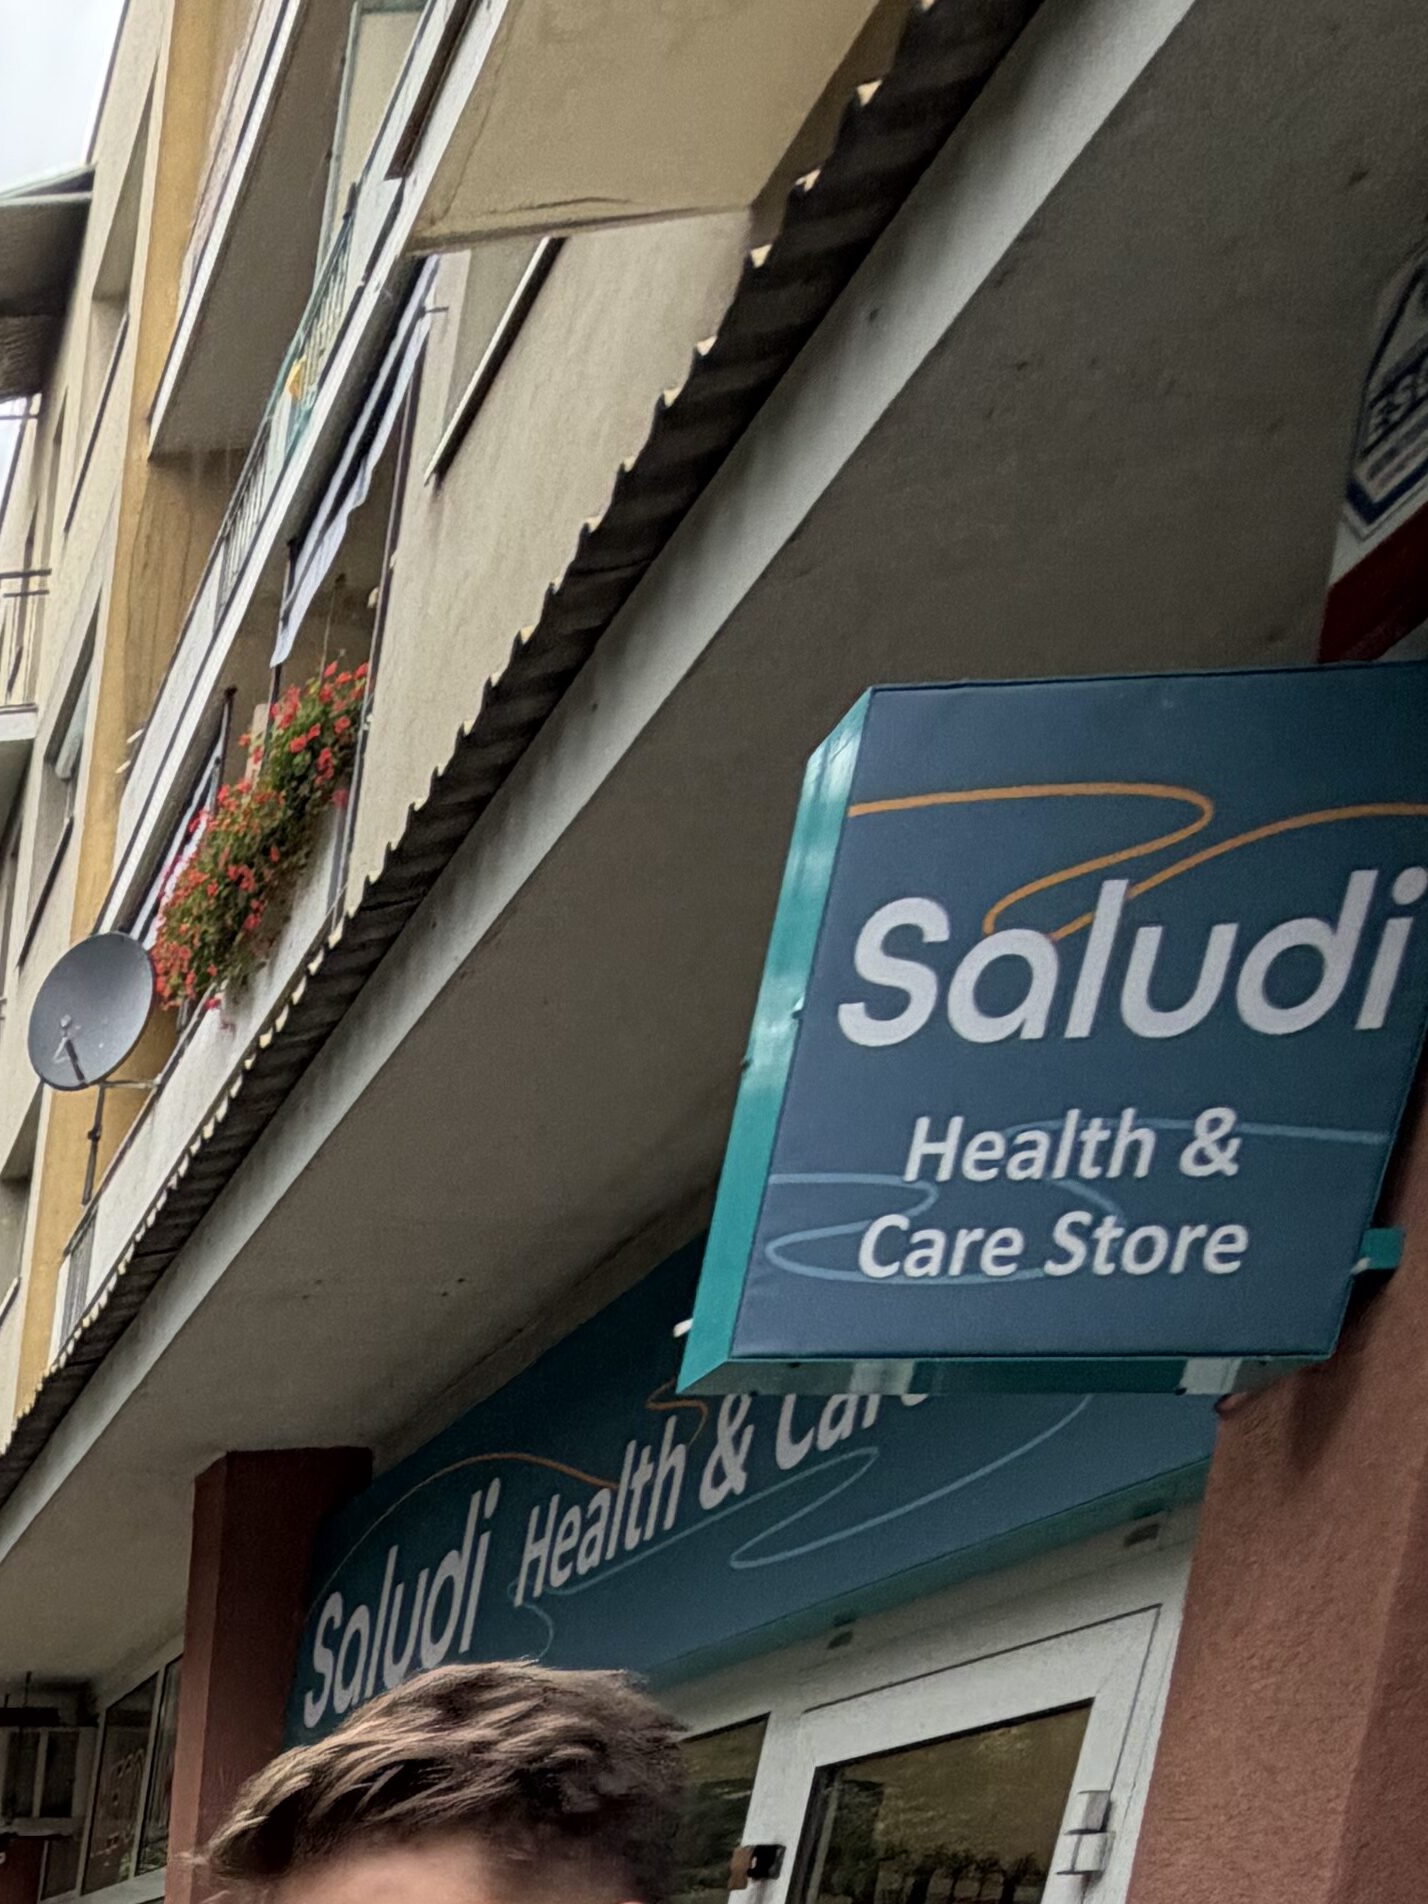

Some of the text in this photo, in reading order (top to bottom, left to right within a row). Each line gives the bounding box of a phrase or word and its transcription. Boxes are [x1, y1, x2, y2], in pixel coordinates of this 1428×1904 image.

[837, 867, 1428, 1047] Saludi
[902, 1106, 1241, 1183] Health &
[858, 1210, 1249, 1280] Care Store
[304, 1393, 928, 1729] Saludi Health & Ca
